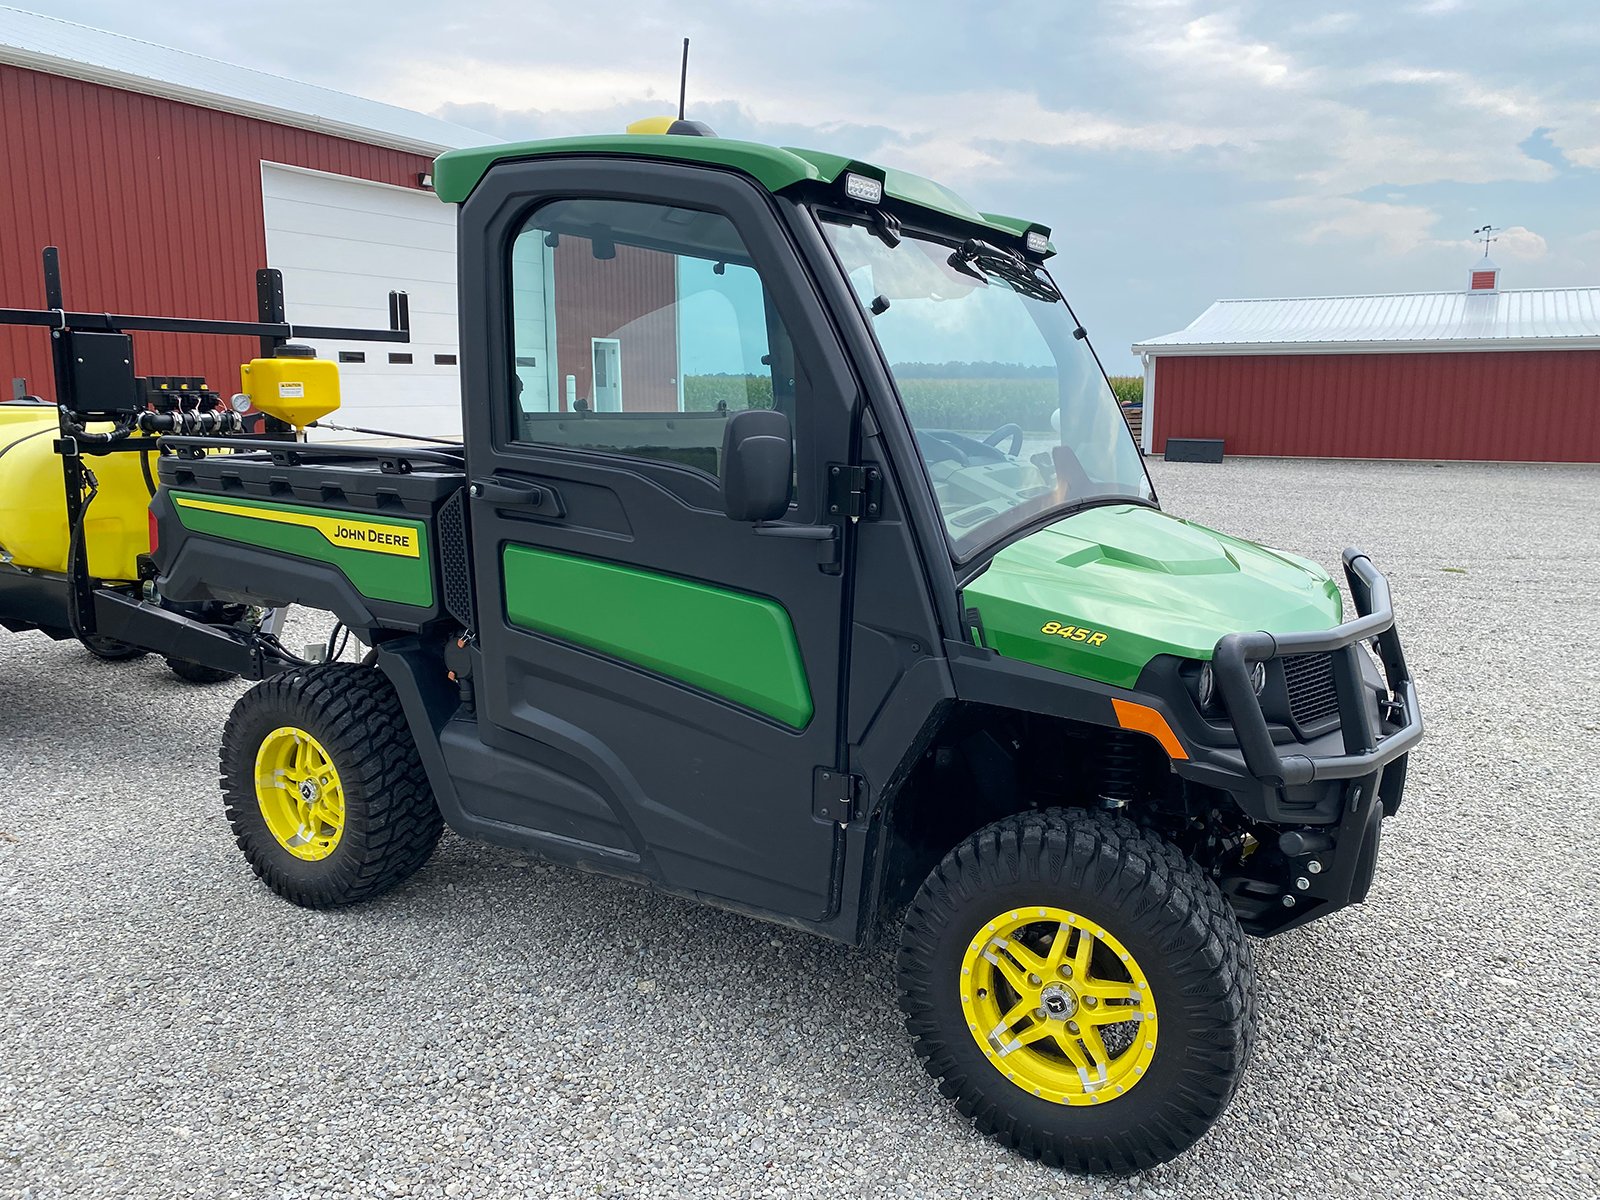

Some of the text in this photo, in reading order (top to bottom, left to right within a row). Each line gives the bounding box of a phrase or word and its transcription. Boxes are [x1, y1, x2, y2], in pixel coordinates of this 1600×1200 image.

[334, 525, 410, 547] JOHN DEERE
[1041, 620, 1108, 647] 845R
